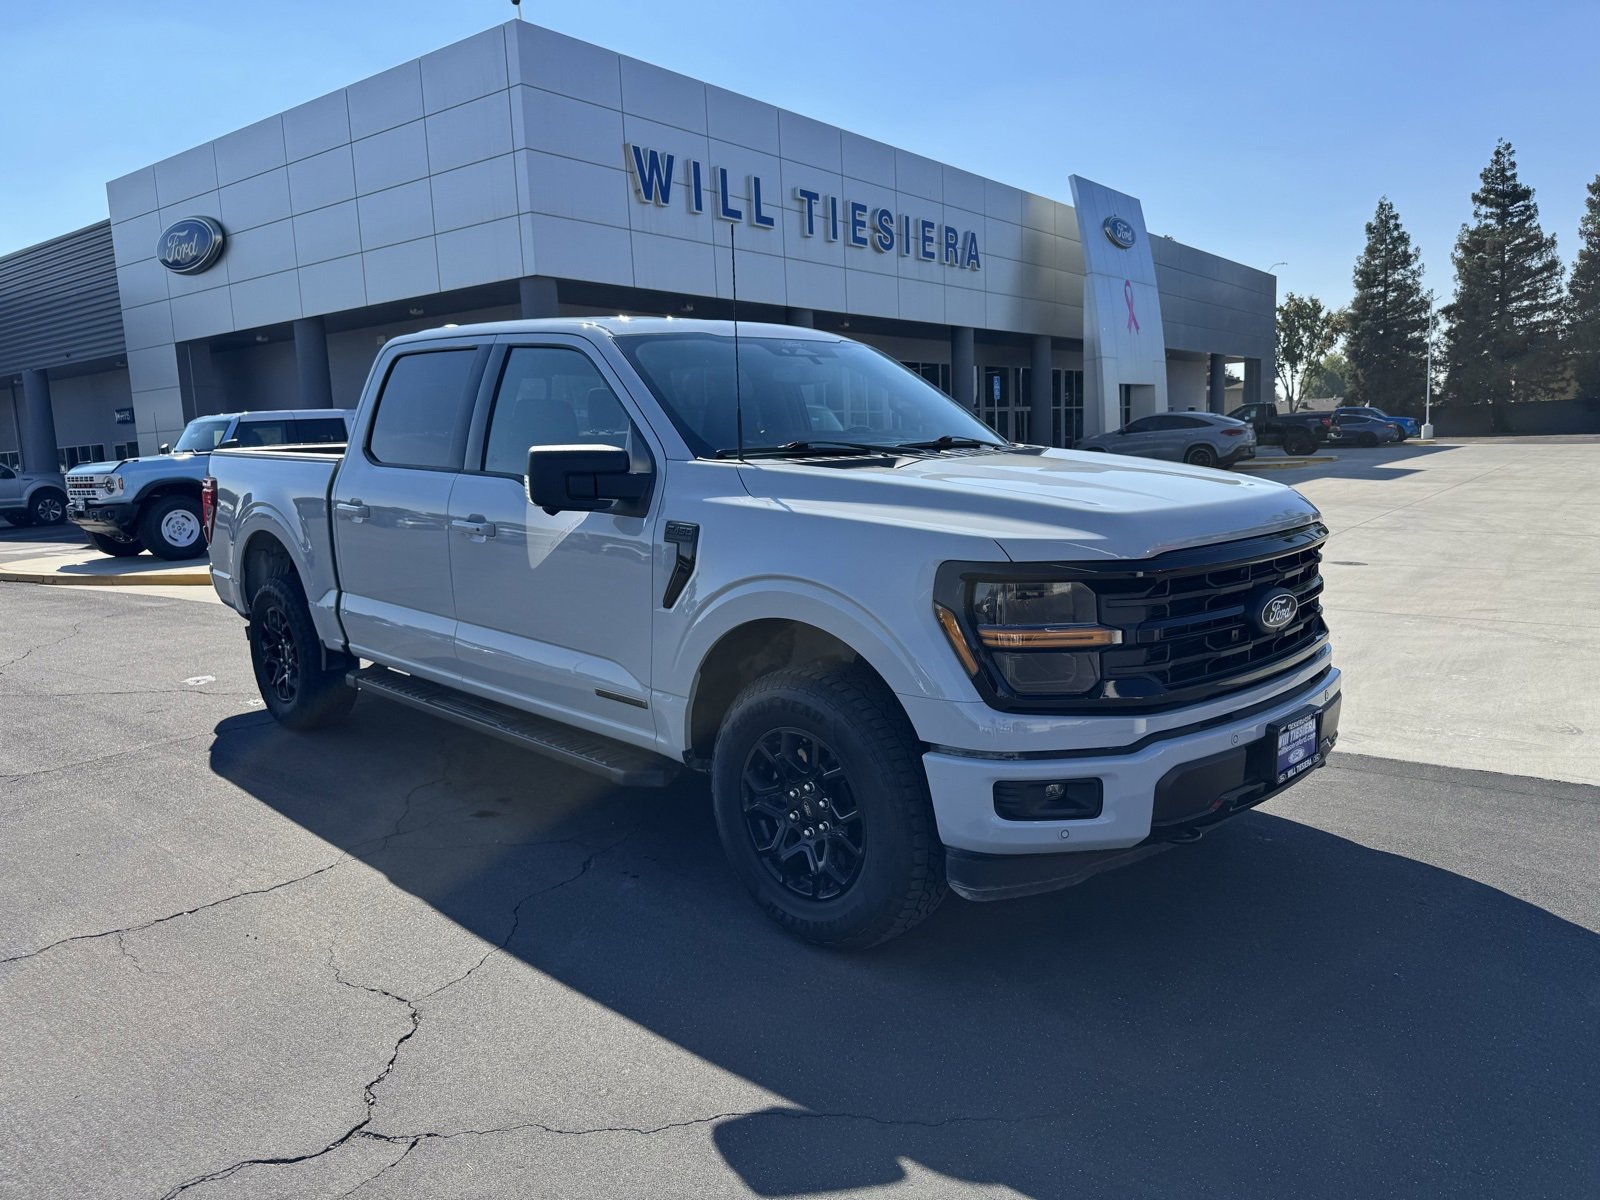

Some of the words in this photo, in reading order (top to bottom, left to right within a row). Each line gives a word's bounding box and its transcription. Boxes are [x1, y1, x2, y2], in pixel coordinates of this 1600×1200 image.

[625, 143, 775, 229] WILL
[795, 186, 981, 271] TIESIERA
[166, 229, 199, 263] Ford
[1116, 222, 1132, 241] Ford
[1269, 599, 1292, 623] Ford
